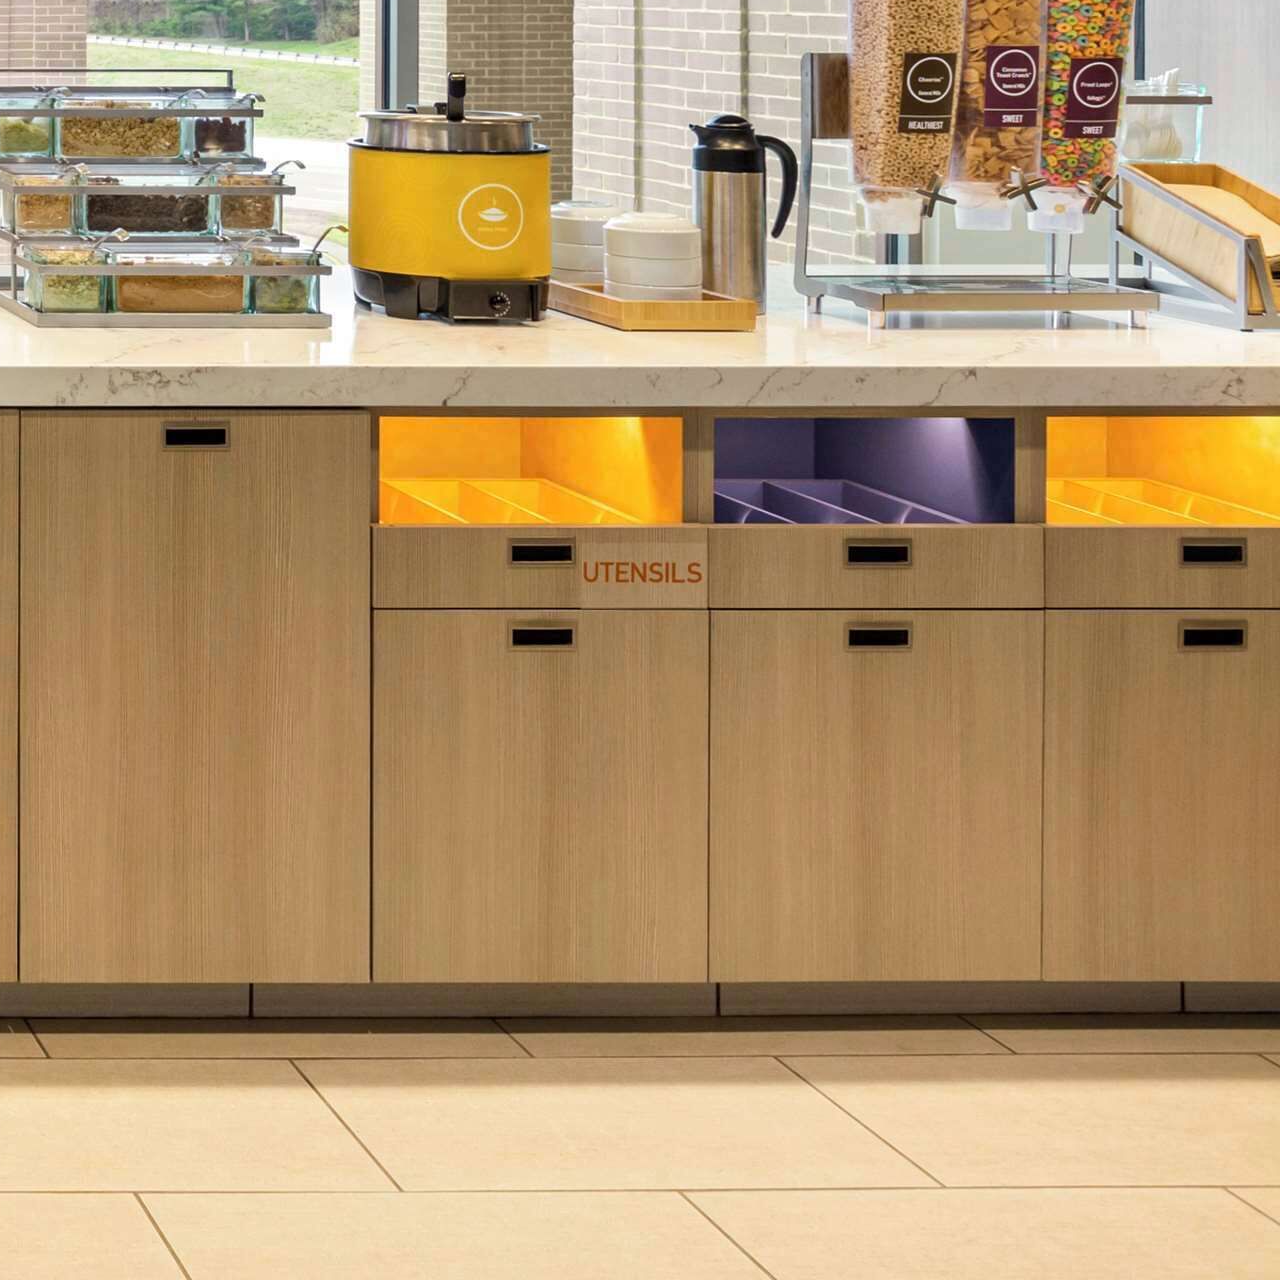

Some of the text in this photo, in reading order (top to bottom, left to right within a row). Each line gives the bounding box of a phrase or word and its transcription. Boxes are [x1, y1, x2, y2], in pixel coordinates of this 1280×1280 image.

[1001, 115, 1024, 123] SWEET
[908, 121, 944, 130] HEALTHIEST
[1082, 126, 1104, 135] SWEET
[583, 560, 702, 583] UTENSILS
